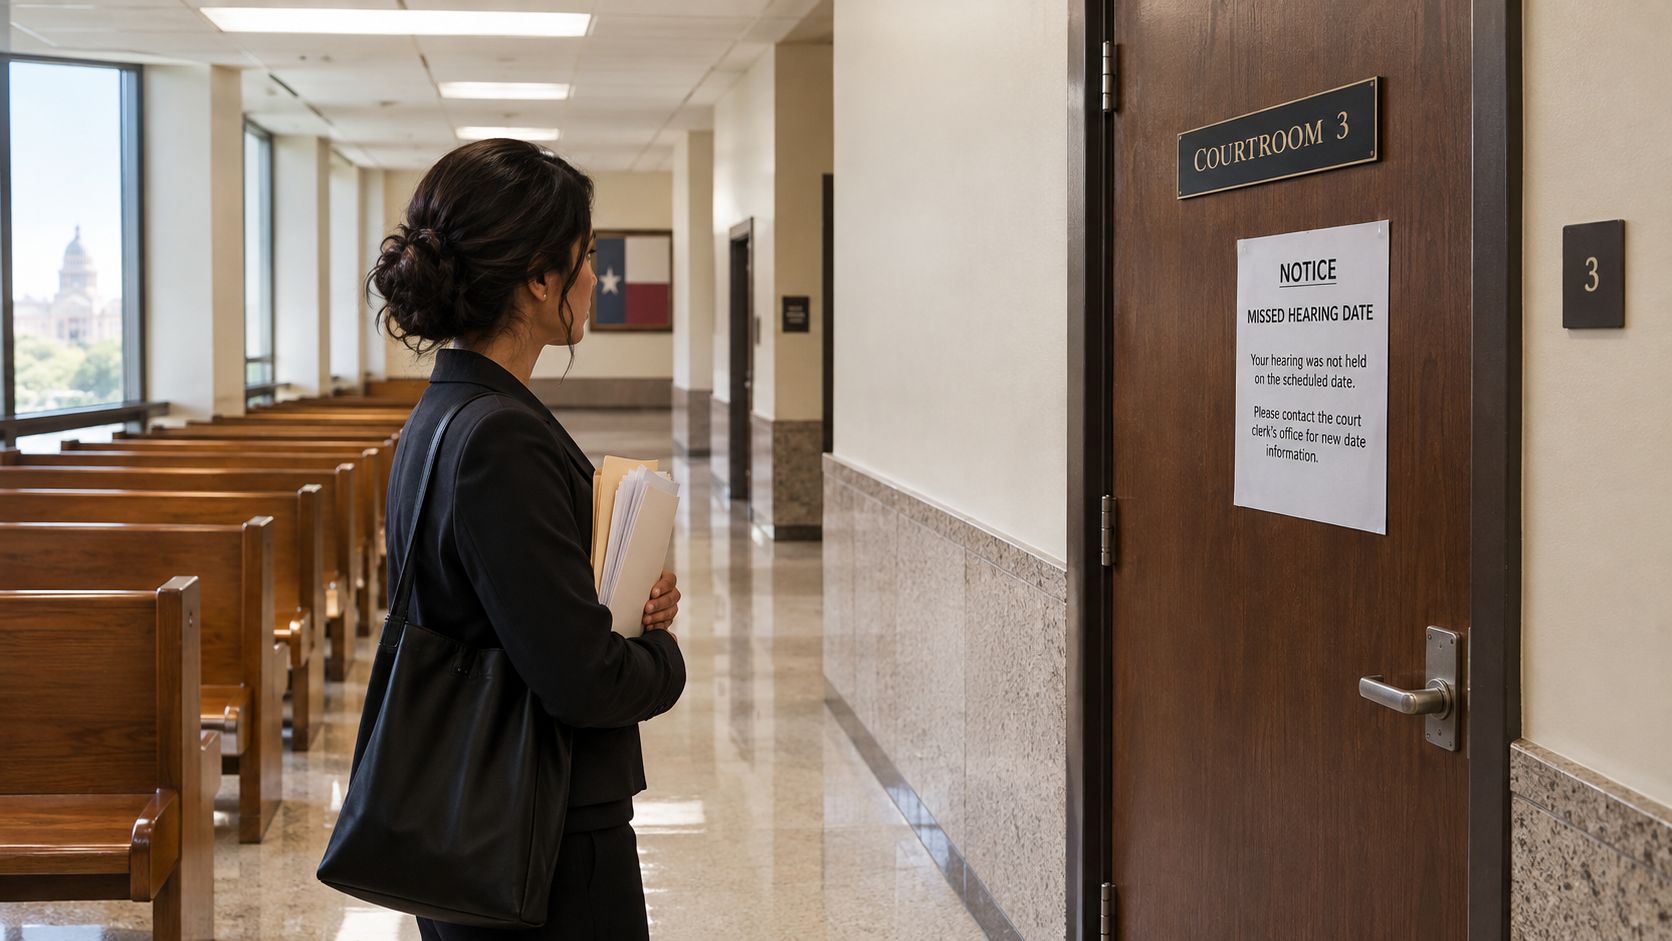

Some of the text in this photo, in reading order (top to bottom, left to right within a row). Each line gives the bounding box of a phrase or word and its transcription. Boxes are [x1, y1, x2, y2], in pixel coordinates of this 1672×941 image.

[1194, 111, 1349, 172] COURTROOM 3
[1280, 258, 1336, 283] NOTICE
[1584, 256, 1599, 292] 3
[1247, 304, 1373, 324] MISSED HEARING DATE
[1250, 353, 1367, 370] Your hearing was not held
[1254, 372, 1355, 389] on the scheduled date.
[1253, 406, 1362, 427] Please contact the court
[1279, 427, 1303, 441] office
[1306, 429, 1319, 443] for
[1321, 434, 1341, 445] new
[1344, 433, 1366, 448] date
[1265, 444, 1319, 463] information.
